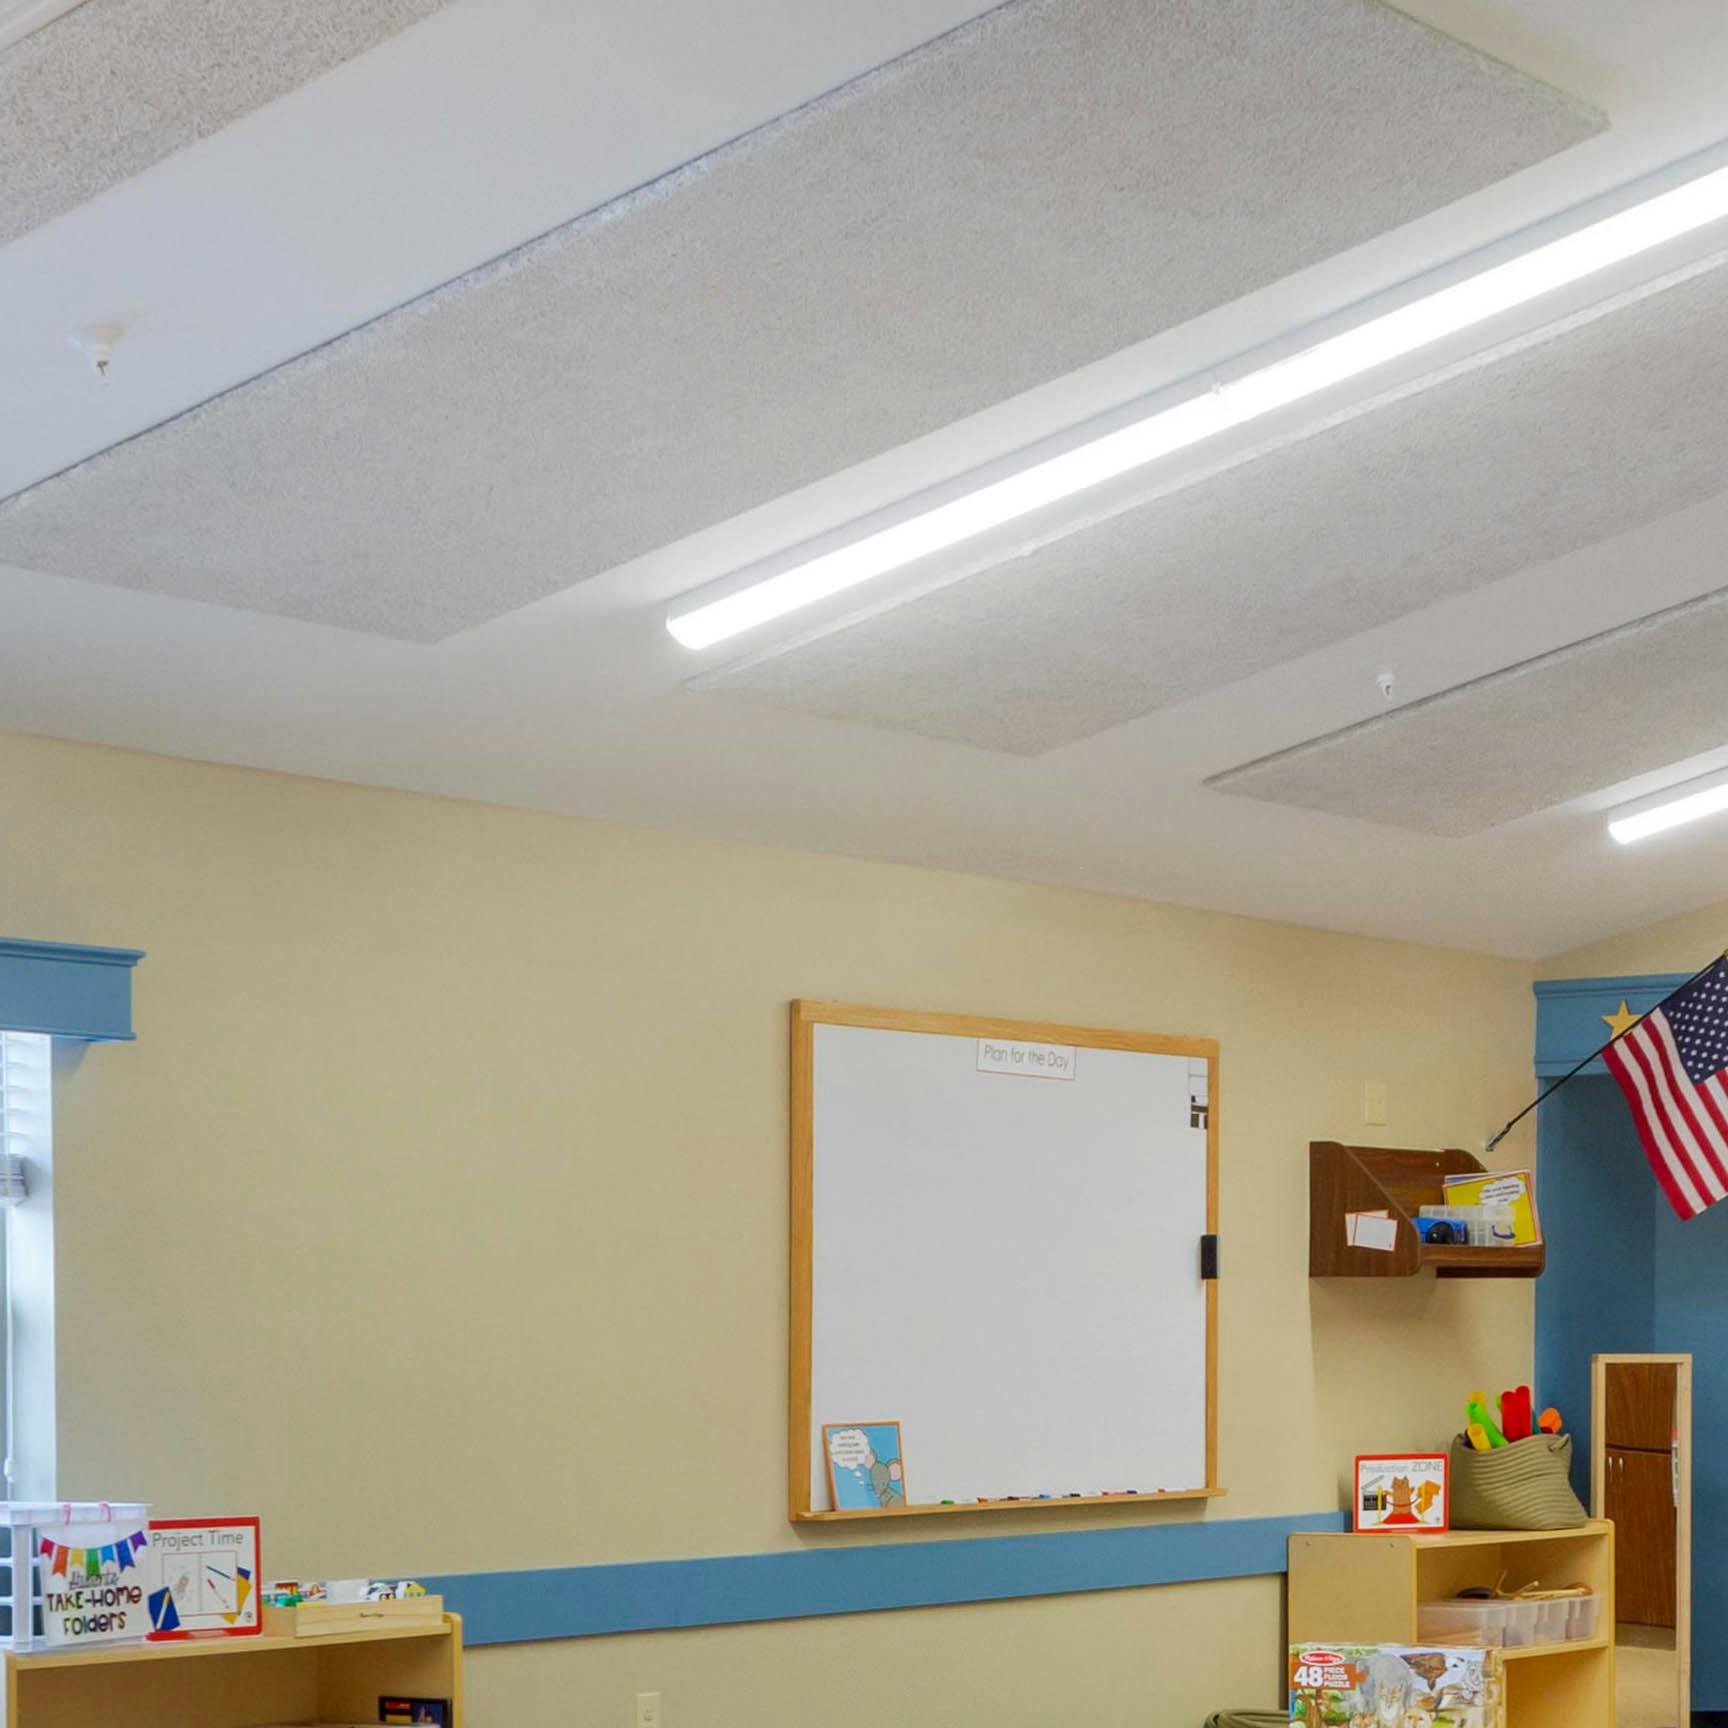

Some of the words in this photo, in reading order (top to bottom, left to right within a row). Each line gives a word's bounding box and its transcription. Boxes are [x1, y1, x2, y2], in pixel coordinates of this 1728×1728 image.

[984, 1044, 1008, 1061] Plan
[1011, 1047, 1025, 1064] for
[1028, 1048, 1046, 1066] the
[1047, 1051, 1070, 1072] Day
[152, 1532, 204, 1551] Project
[208, 1530, 244, 1545] Time
[1294, 1666, 1323, 1688] 48
